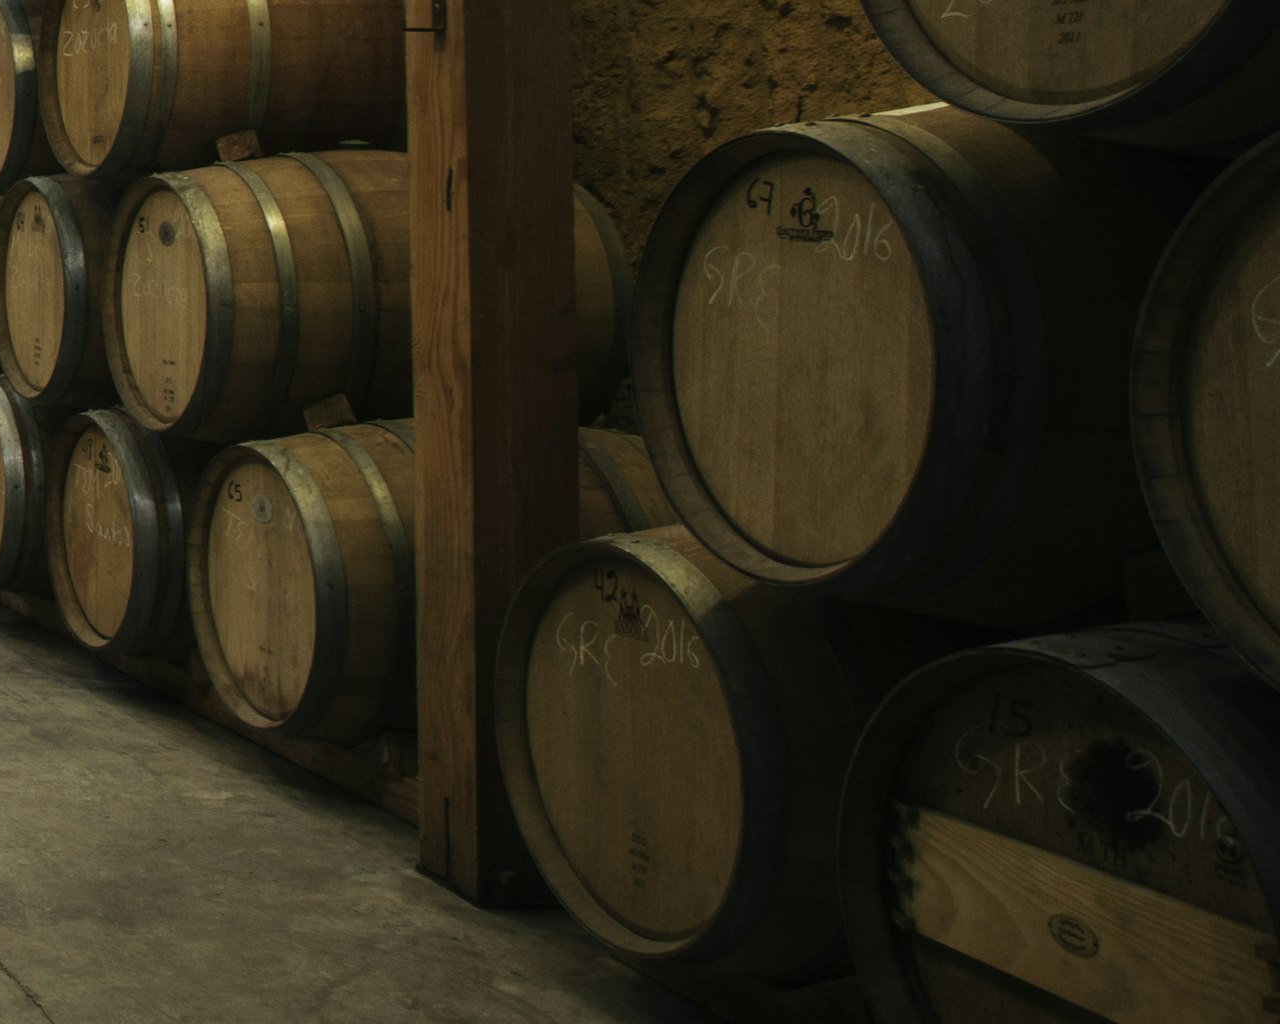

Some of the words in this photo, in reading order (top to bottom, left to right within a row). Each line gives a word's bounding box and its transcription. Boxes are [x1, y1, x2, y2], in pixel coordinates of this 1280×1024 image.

[815, 196, 893, 261] 2016
[594, 567, 618, 603] 42
[641, 604, 701, 670] 2016
[989, 691, 1034, 737] 15
